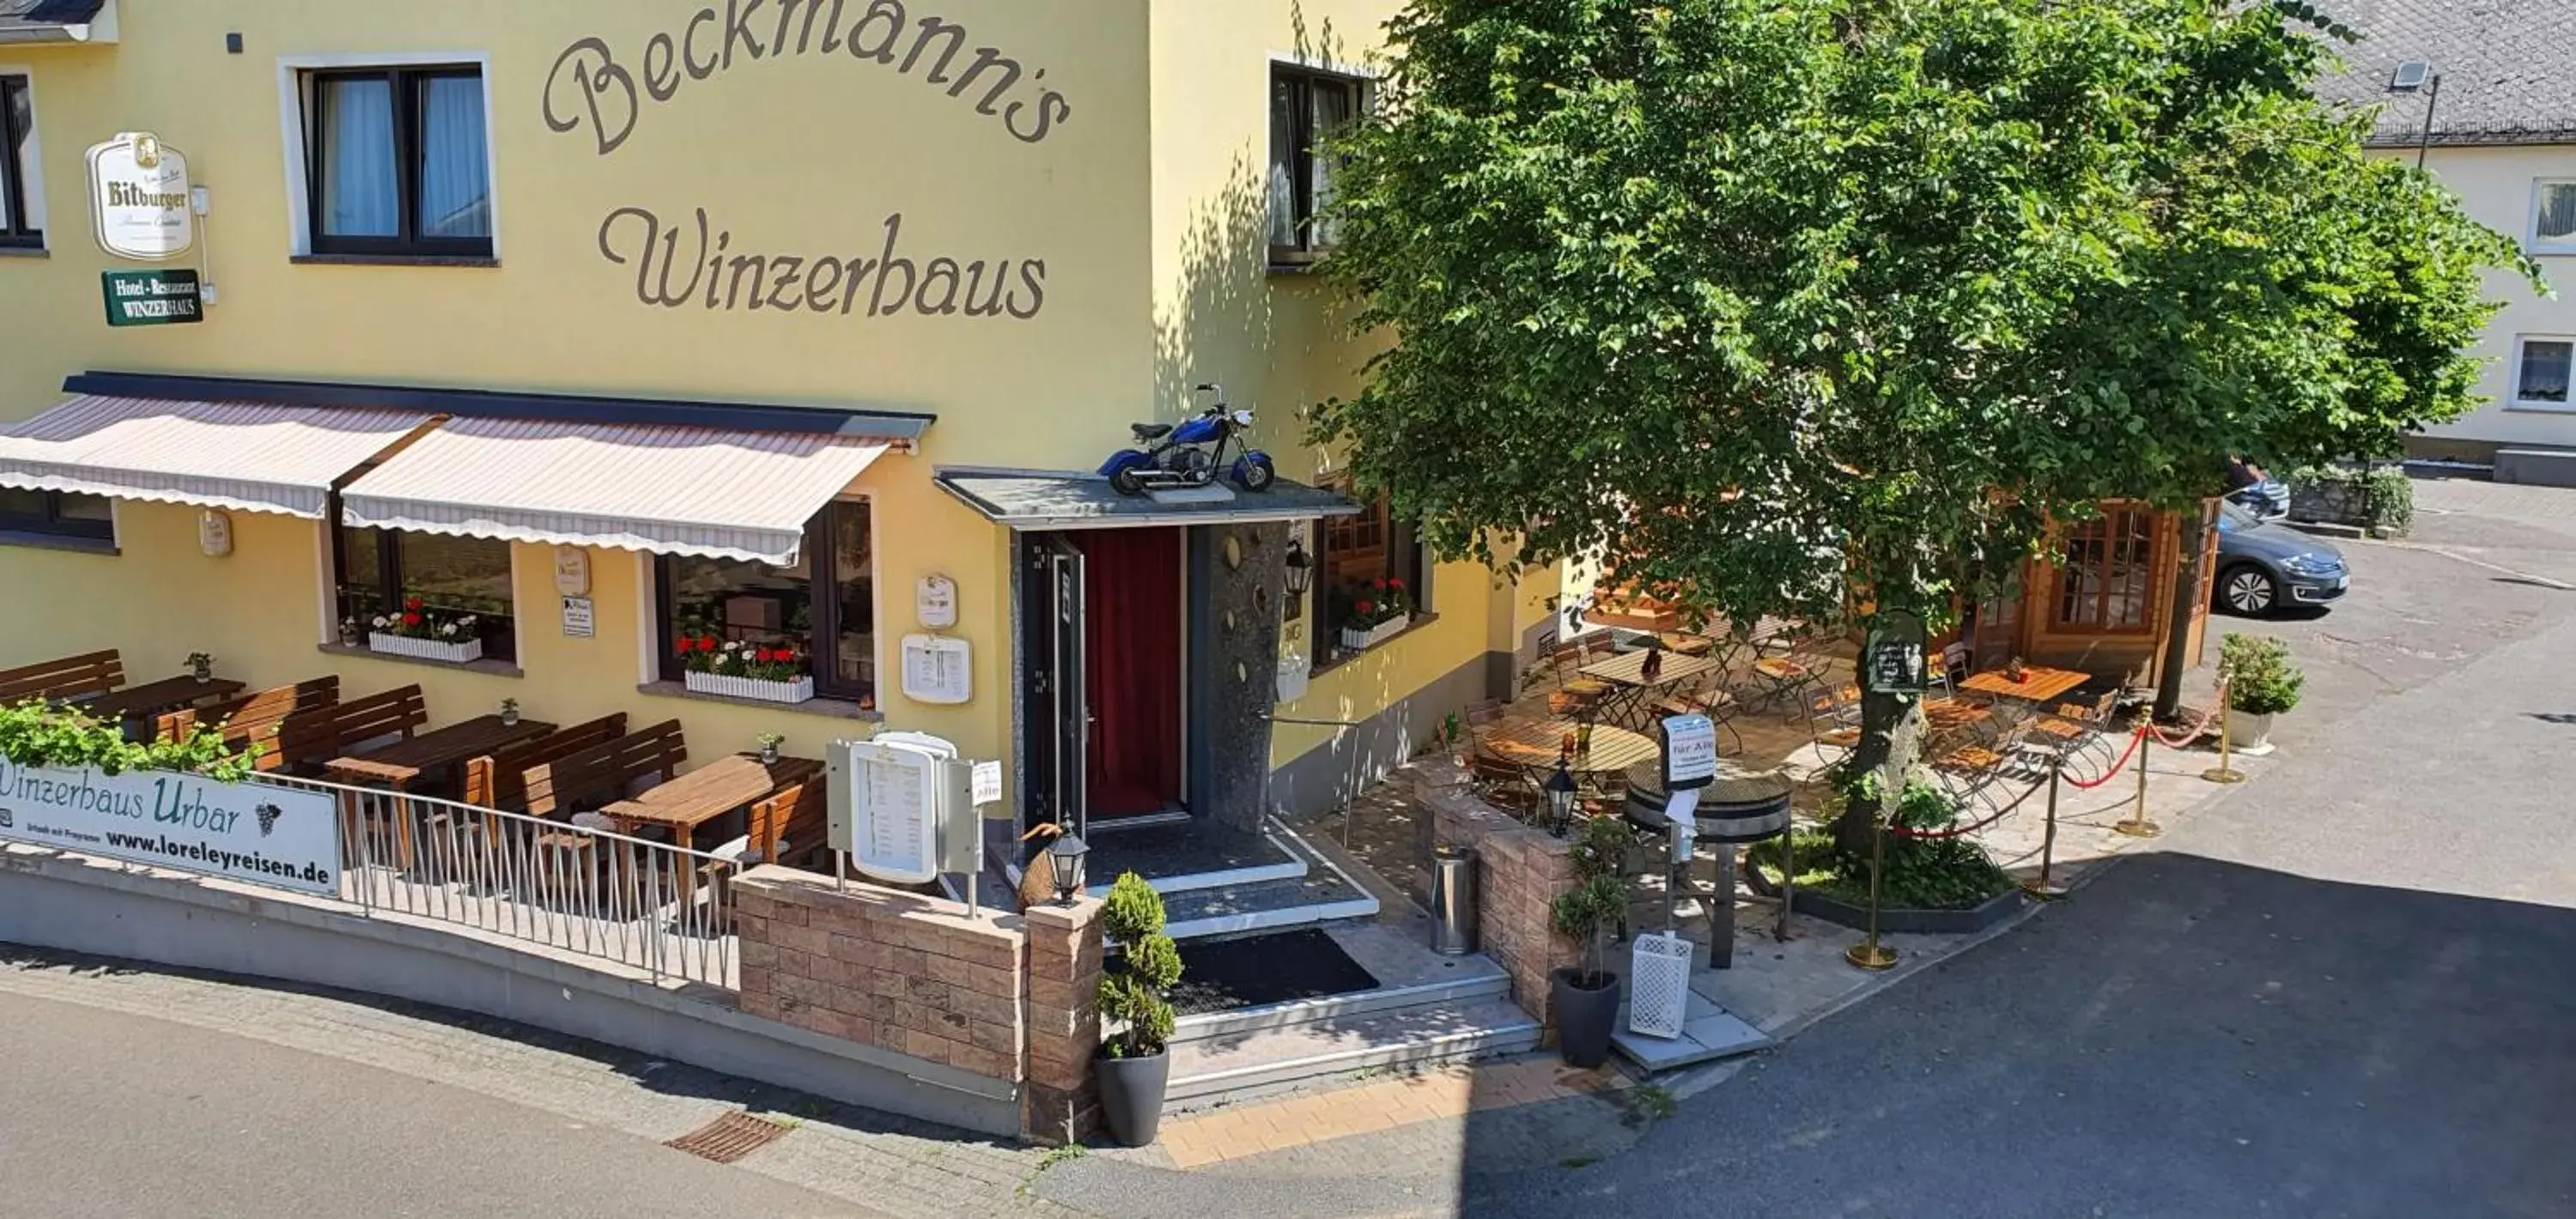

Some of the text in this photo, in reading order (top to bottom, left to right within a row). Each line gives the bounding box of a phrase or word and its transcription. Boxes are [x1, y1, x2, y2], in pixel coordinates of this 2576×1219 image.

[543, 0, 1071, 155] Beckmann's
[108, 180, 186, 211] Bitburger
[115, 278, 144, 296] Hotel
[598, 207, 1046, 319] Winzerhaus
[123, 299, 196, 318] WINZERHAUS
[154, 776, 240, 835] Urbar
[106, 830, 330, 884] www.loreleyreisen.de
